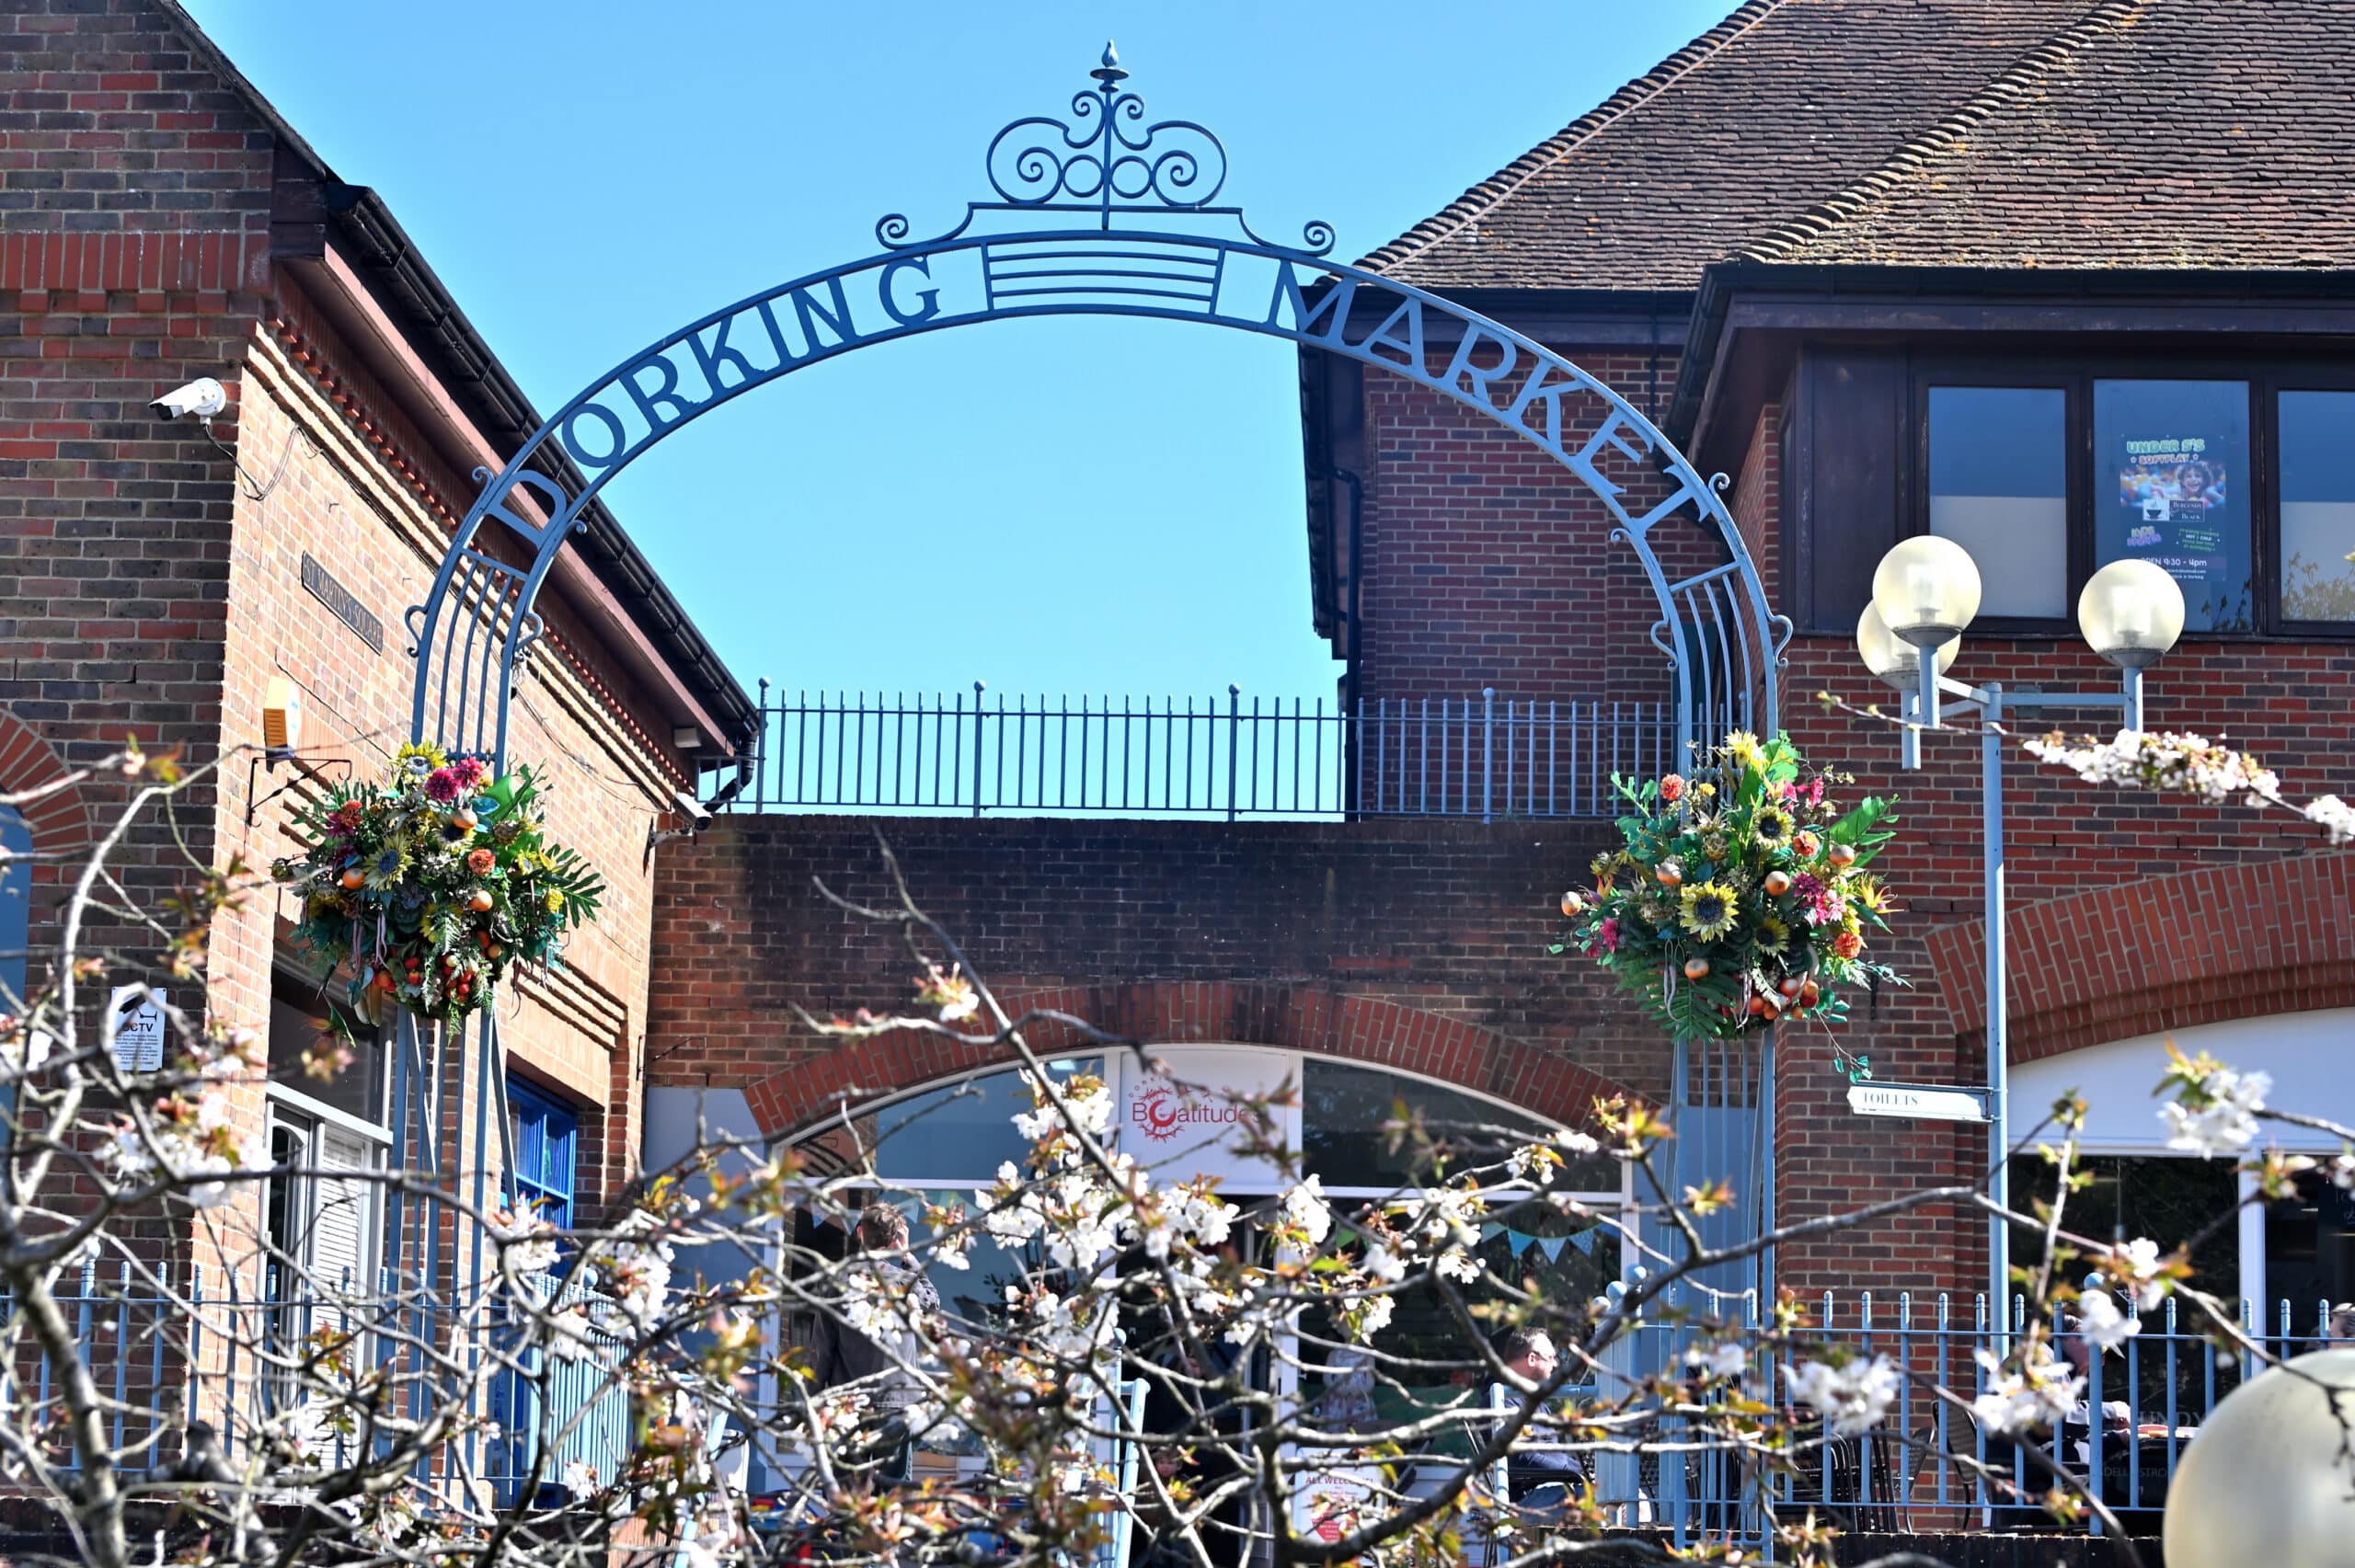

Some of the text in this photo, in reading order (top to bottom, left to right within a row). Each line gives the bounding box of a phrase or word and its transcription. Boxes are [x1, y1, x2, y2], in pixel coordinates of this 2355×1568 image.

[486, 257, 1711, 549] DORKING MARKET
[2126, 440, 2180, 453] UNDER
[2138, 453, 2189, 464] SOFTPLAY
[2142, 557, 2162, 566] PEN
[2188, 558, 2208, 567] 4pm
[1861, 1091, 1919, 1105] TOILETS
[1132, 1100, 1258, 1127] Beatitude
[1305, 1476, 1374, 1485] ALL WELC!
